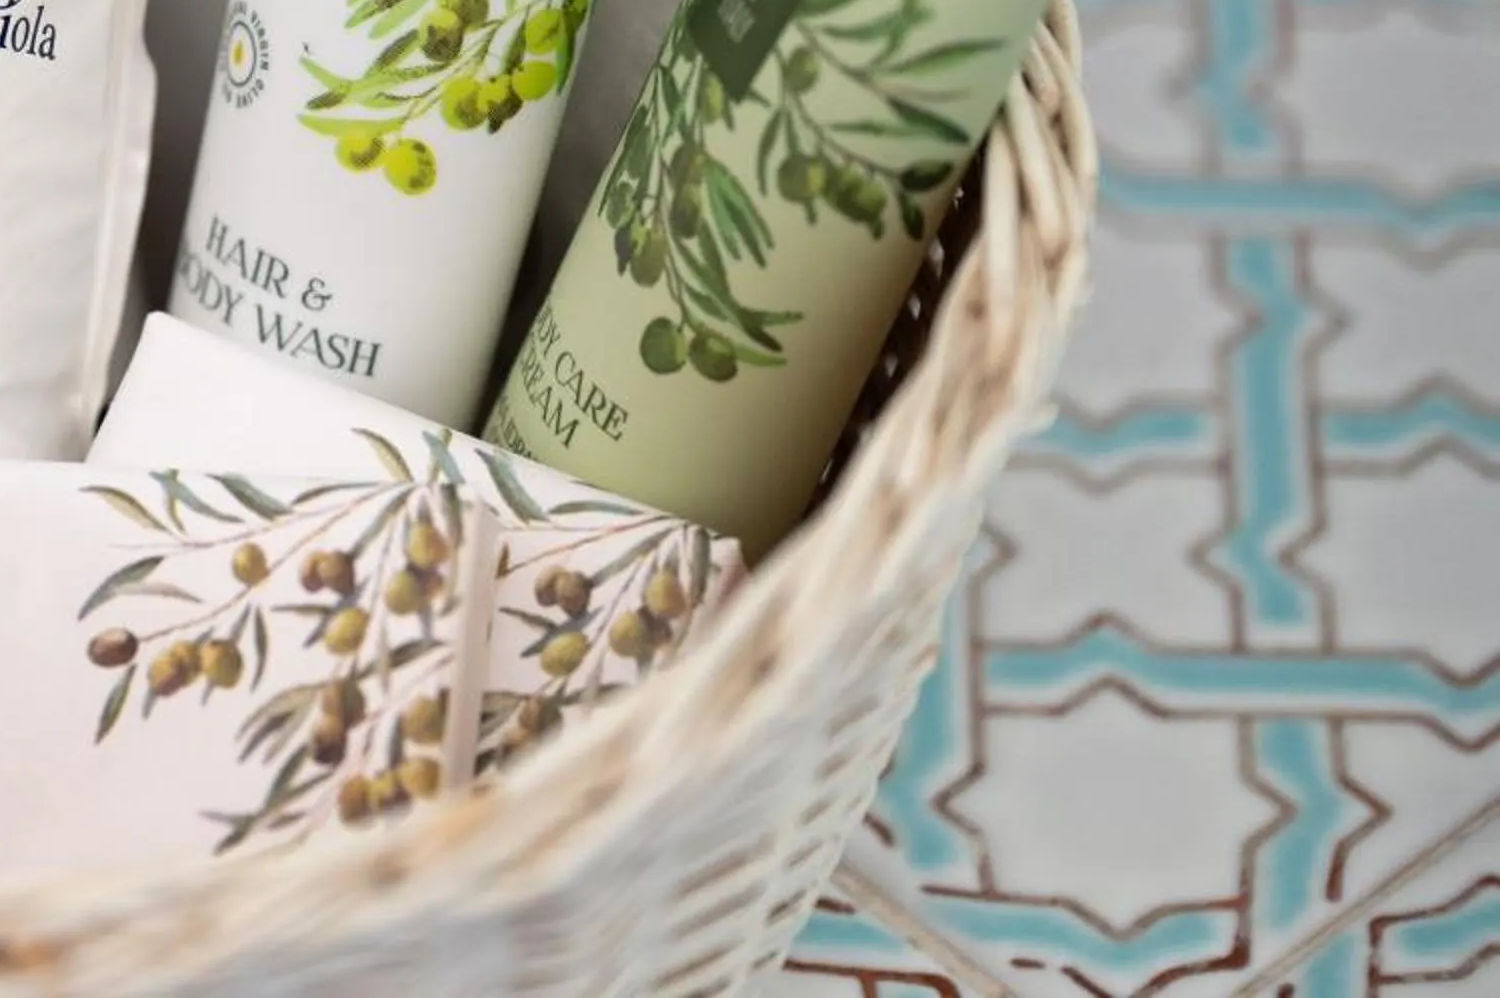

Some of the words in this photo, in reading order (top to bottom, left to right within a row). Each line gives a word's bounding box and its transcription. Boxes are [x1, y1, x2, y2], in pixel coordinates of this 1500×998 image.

[204, 214, 290, 299] HAIR
[301, 276, 333, 312] &
[175, 253, 244, 326] ODY
[255, 303, 383, 378] WASH
[521, 348, 579, 449] REAM
[554, 351, 628, 442] CARE
